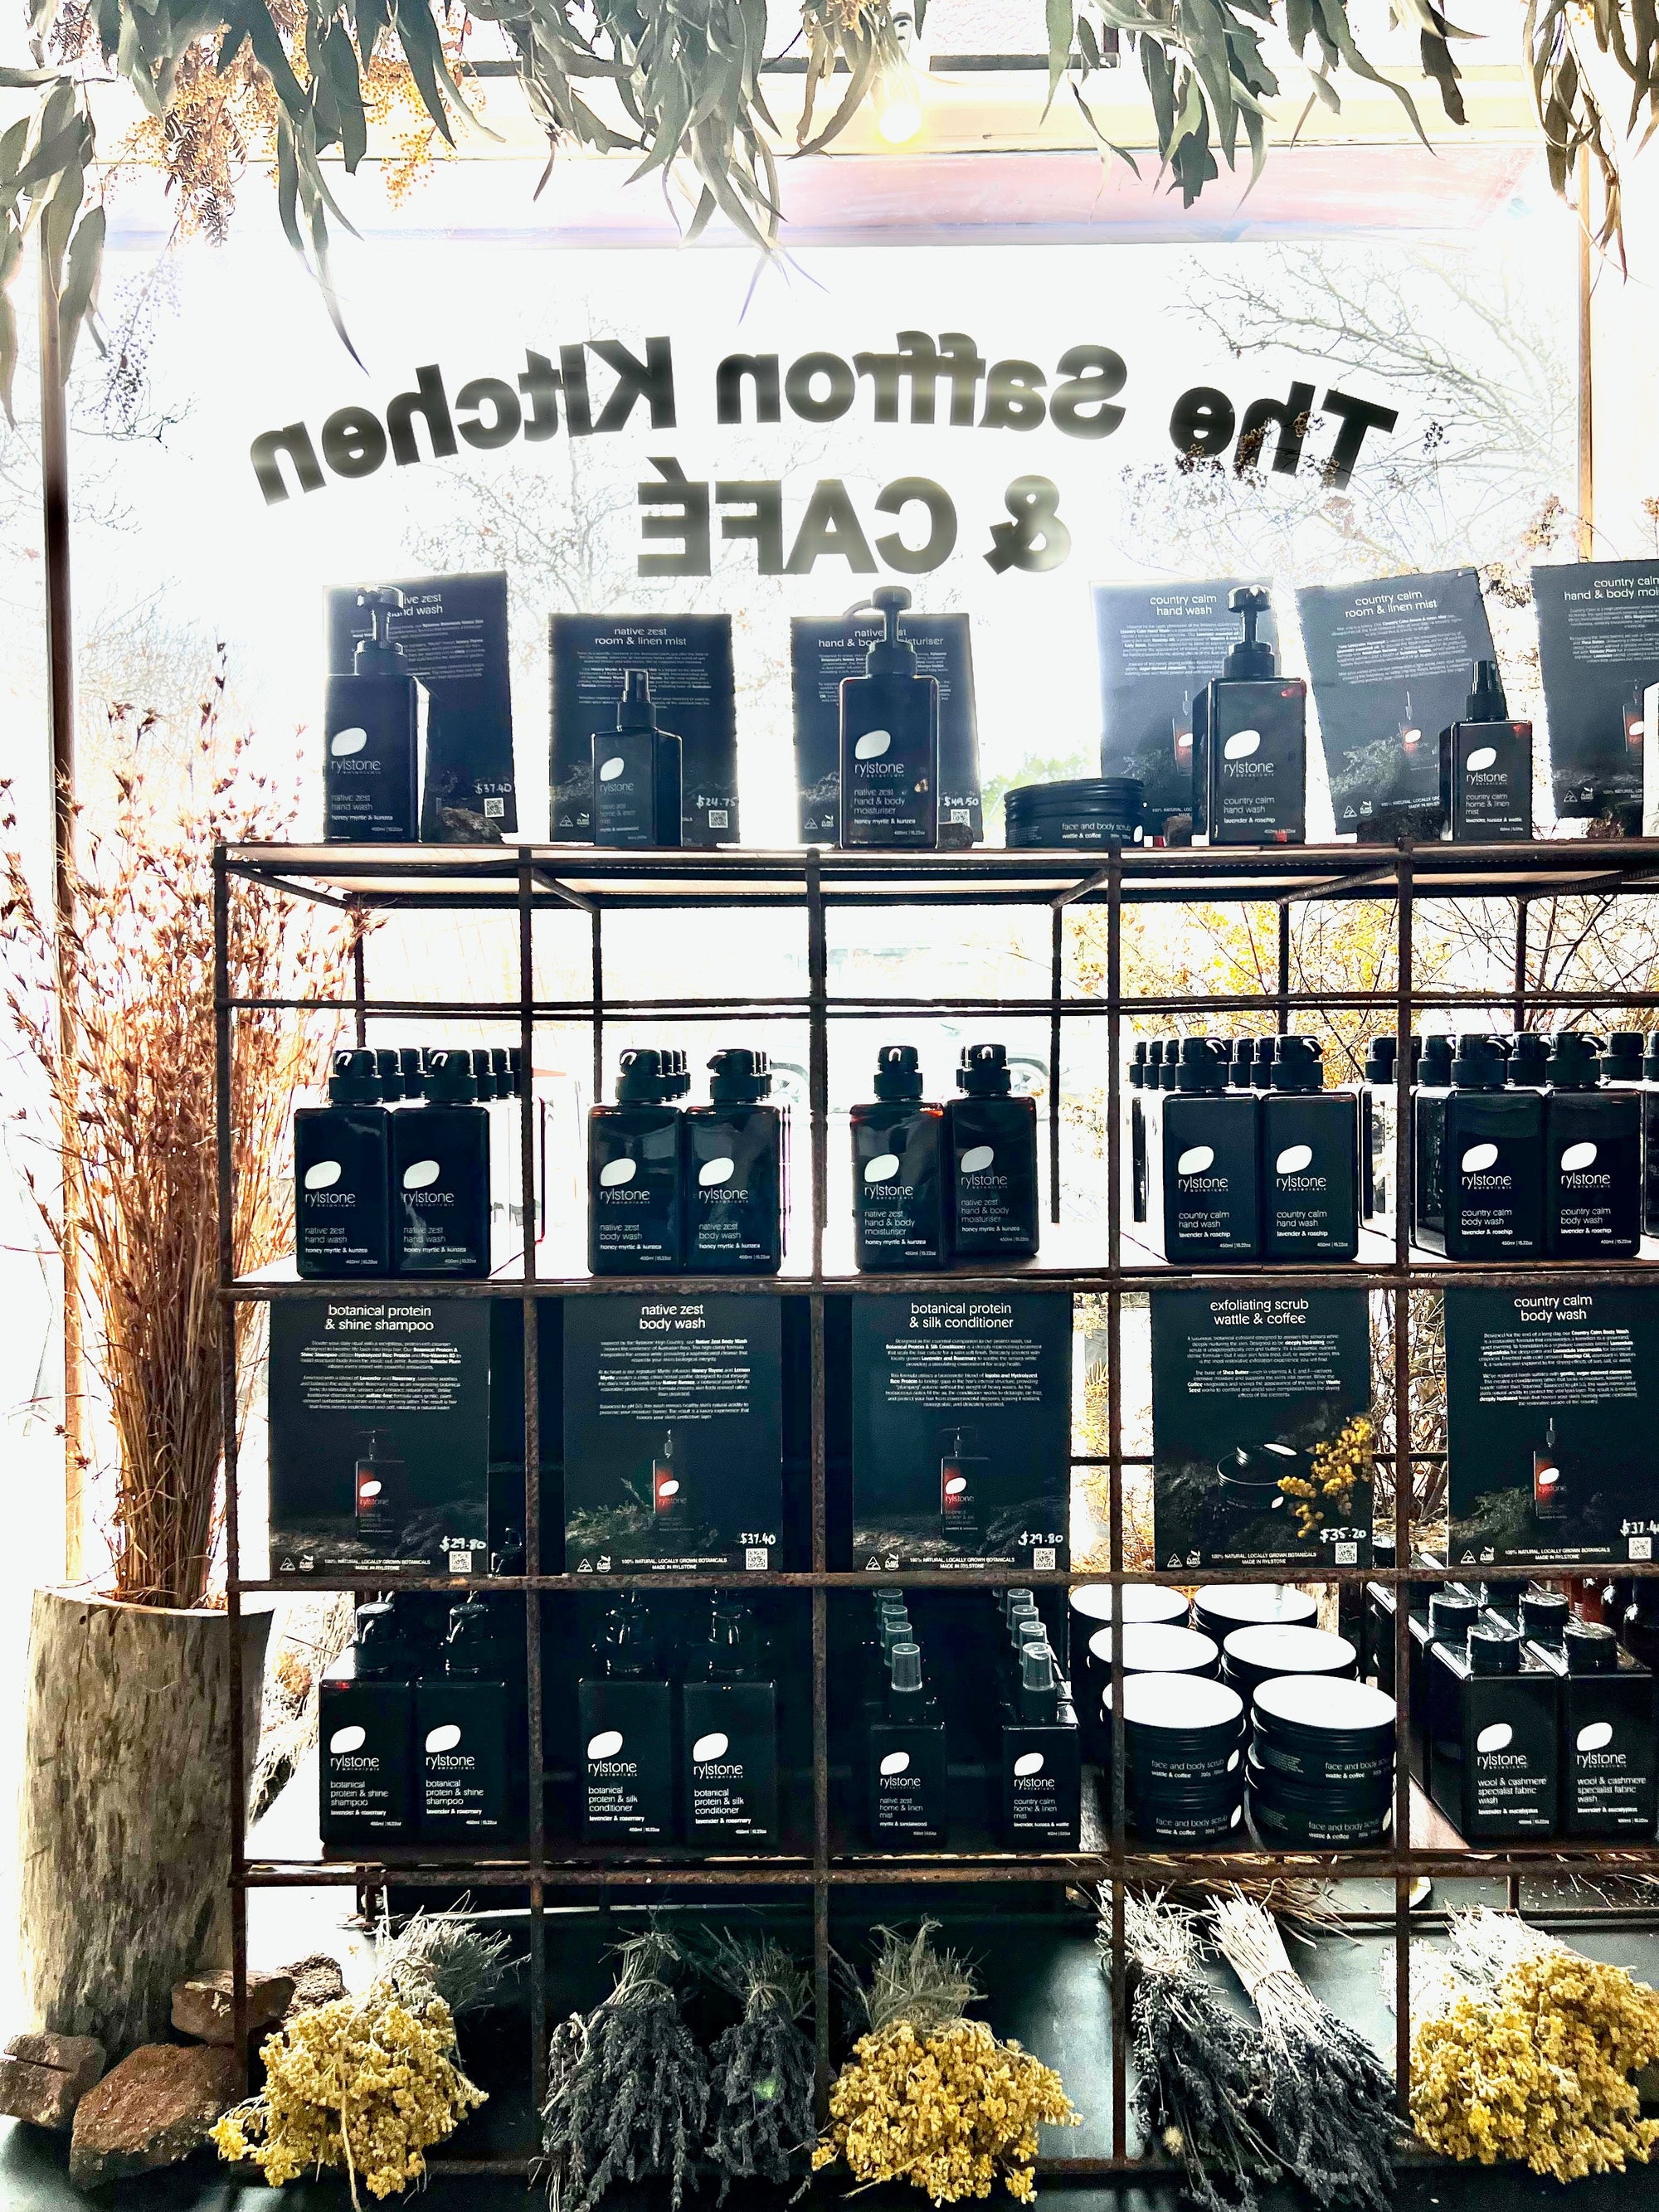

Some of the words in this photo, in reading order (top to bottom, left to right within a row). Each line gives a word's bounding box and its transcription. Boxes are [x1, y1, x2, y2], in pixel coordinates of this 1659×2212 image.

[1594, 578, 1634, 588] country
[421, 594, 441, 603] zest
[1150, 596, 1190, 605] country
[1192, 595, 1217, 604] calm
[1355, 595, 1394, 606] country
[1397, 591, 1422, 600] calm
[1564, 591, 1591, 600] hand
[1595, 591, 1603, 599] &
[1607, 589, 1634, 599] body
[416, 606, 443, 615] wash
[1156, 606, 1182, 615] hand
[1185, 606, 1212, 615] wash
[1345, 607, 1373, 618] room
[1377, 605, 1385, 615] &
[1389, 603, 1412, 613] linen
[1415, 599, 1438, 610] mist
[615, 627, 645, 636] native
[626, 637, 635, 645] &
[638, 637, 662, 645] linen
[665, 637, 687, 645] mist
[819, 639, 844, 647] hand
[847, 639, 855, 647] &
[332, 759, 381, 774] rylstone
[854, 762, 904, 777] rylstone
[1224, 761, 1273, 777] rylstone
[1467, 773, 1507, 785] rylstone
[600, 783, 635, 795] rylstone
[696, 795, 737, 809] $24.75
[854, 797, 873, 805] hand
[876, 797, 882, 805] &
[884, 797, 905, 806] body
[1097, 823, 1115, 831] body
[961, 1174, 1007, 1189] rylstone
[1178, 1177, 1228, 1192] rylstone
[1277, 1176, 1326, 1191] rylstone
[1462, 1174, 1511, 1189] rylstone
[1561, 1173, 1610, 1189] rylstone
[601, 1189, 649, 1204] rylstone
[699, 1189, 748, 1203] rylstone
[865, 1184, 912, 1199] rylstone
[305, 1192, 356, 1207] rylstone
[404, 1191, 454, 1207] rylstone
[1179, 1212, 1207, 1220] country
[1277, 1211, 1305, 1219] country
[1462, 1209, 1491, 1218] country
[895, 1218, 915, 1228] body
[1462, 1218, 1481, 1226] body
[601, 1232, 621, 1241] body
[1210, 1300, 1271, 1313] exfoliating
[1275, 1299, 1308, 1310] scrub
[1514, 1297, 1559, 1308] country
[1564, 1295, 1592, 1305] calm
[328, 1305, 384, 1315] botanical
[389, 1305, 431, 1318] protein
[642, 1304, 677, 1315] native
[680, 1305, 703, 1315] zest
[912, 1303, 965, 1313] botanical
[970, 1304, 1011, 1315] protein
[1520, 1310, 1552, 1323] body
[1557, 1308, 1587, 1320] wash
[324, 1319, 335, 1330] &
[338, 1320, 372, 1330] shine
[375, 1320, 434, 1332] shampoo
[640, 1319, 671, 1331] body
[675, 1318, 705, 1329] wash
[909, 1317, 919, 1328] &
[922, 1317, 941, 1327] silk
[945, 1317, 1013, 1328] conditioner
[1214, 1314, 1249, 1325] wattle
[1253, 1313, 1262, 1324] &
[1267, 1313, 1306, 1324] coffee
[740, 1533, 776, 1544] $37.40
[1018, 1531, 1063, 1545] $29.80
[1320, 1528, 1366, 1543] $35.20
[440, 1536, 486, 1551] $29.80
[331, 1755, 379, 1771] rylstone
[426, 1754, 474, 1770] rylstone
[1151, 1760, 1167, 1769] face
[1170, 1762, 1185, 1770] and
[1186, 1761, 1204, 1771] body
[1477, 1753, 1527, 1770] rylstone
[1577, 1753, 1626, 1768] rylstone
[588, 1761, 637, 1777] rylstone
[694, 1763, 743, 1779] rylstone
[880, 1777, 921, 1790] rylstone
[1014, 1777, 1054, 1790] rylstone
[426, 1788, 453, 1796] protein
[589, 1796, 615, 1804] protein
